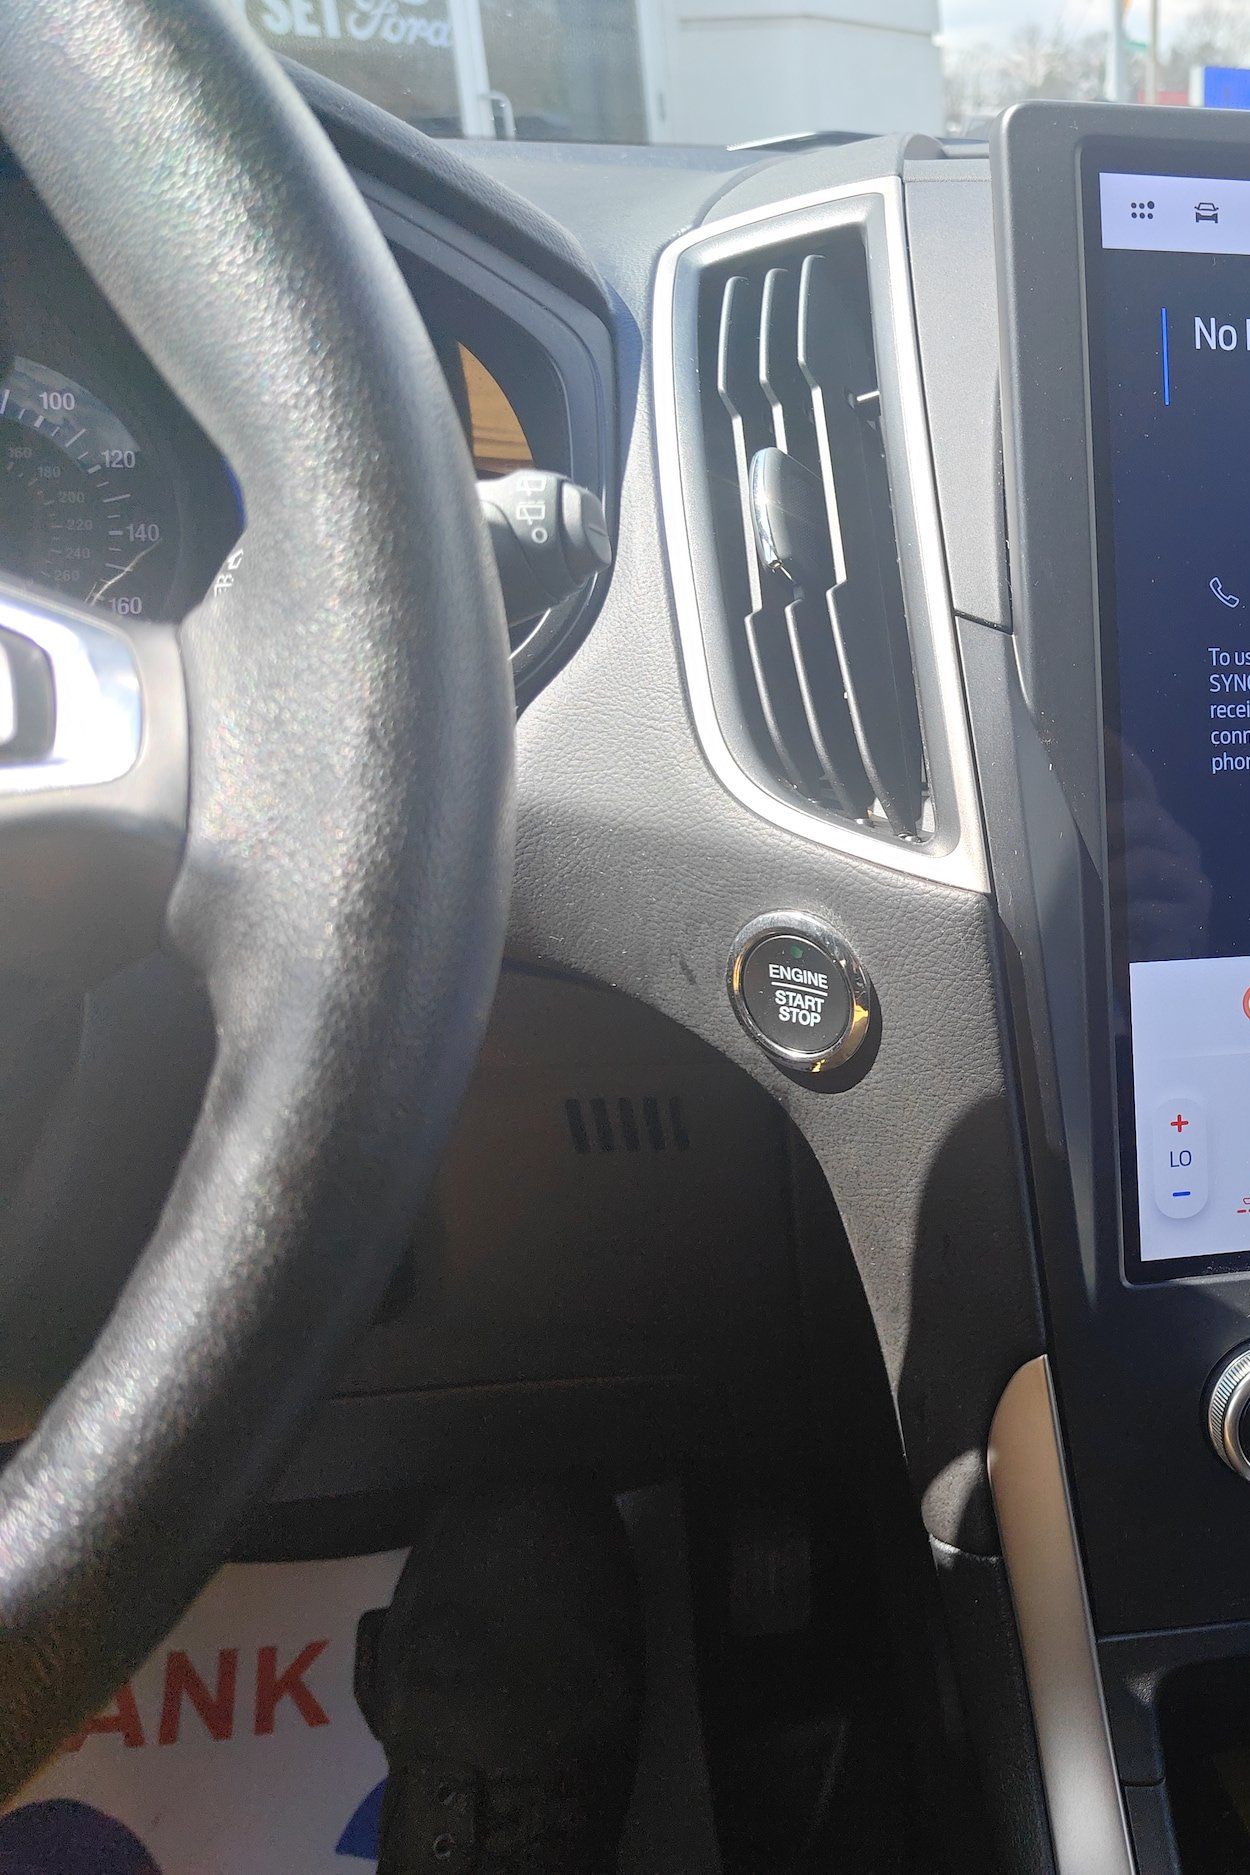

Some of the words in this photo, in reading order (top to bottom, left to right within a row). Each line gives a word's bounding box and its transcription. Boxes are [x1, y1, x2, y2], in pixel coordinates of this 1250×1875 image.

[1194, 316, 1238, 351] No
[39, 392, 76, 411] 100
[101, 450, 136, 469] 120
[126, 523, 160, 542] 140
[109, 596, 143, 615] 160
[1208, 648, 1231, 666] To
[768, 963, 829, 989] ENGINE
[774, 989, 825, 1013] START
[778, 1006, 822, 1028] STOP
[1169, 1149, 1192, 1168] LO
